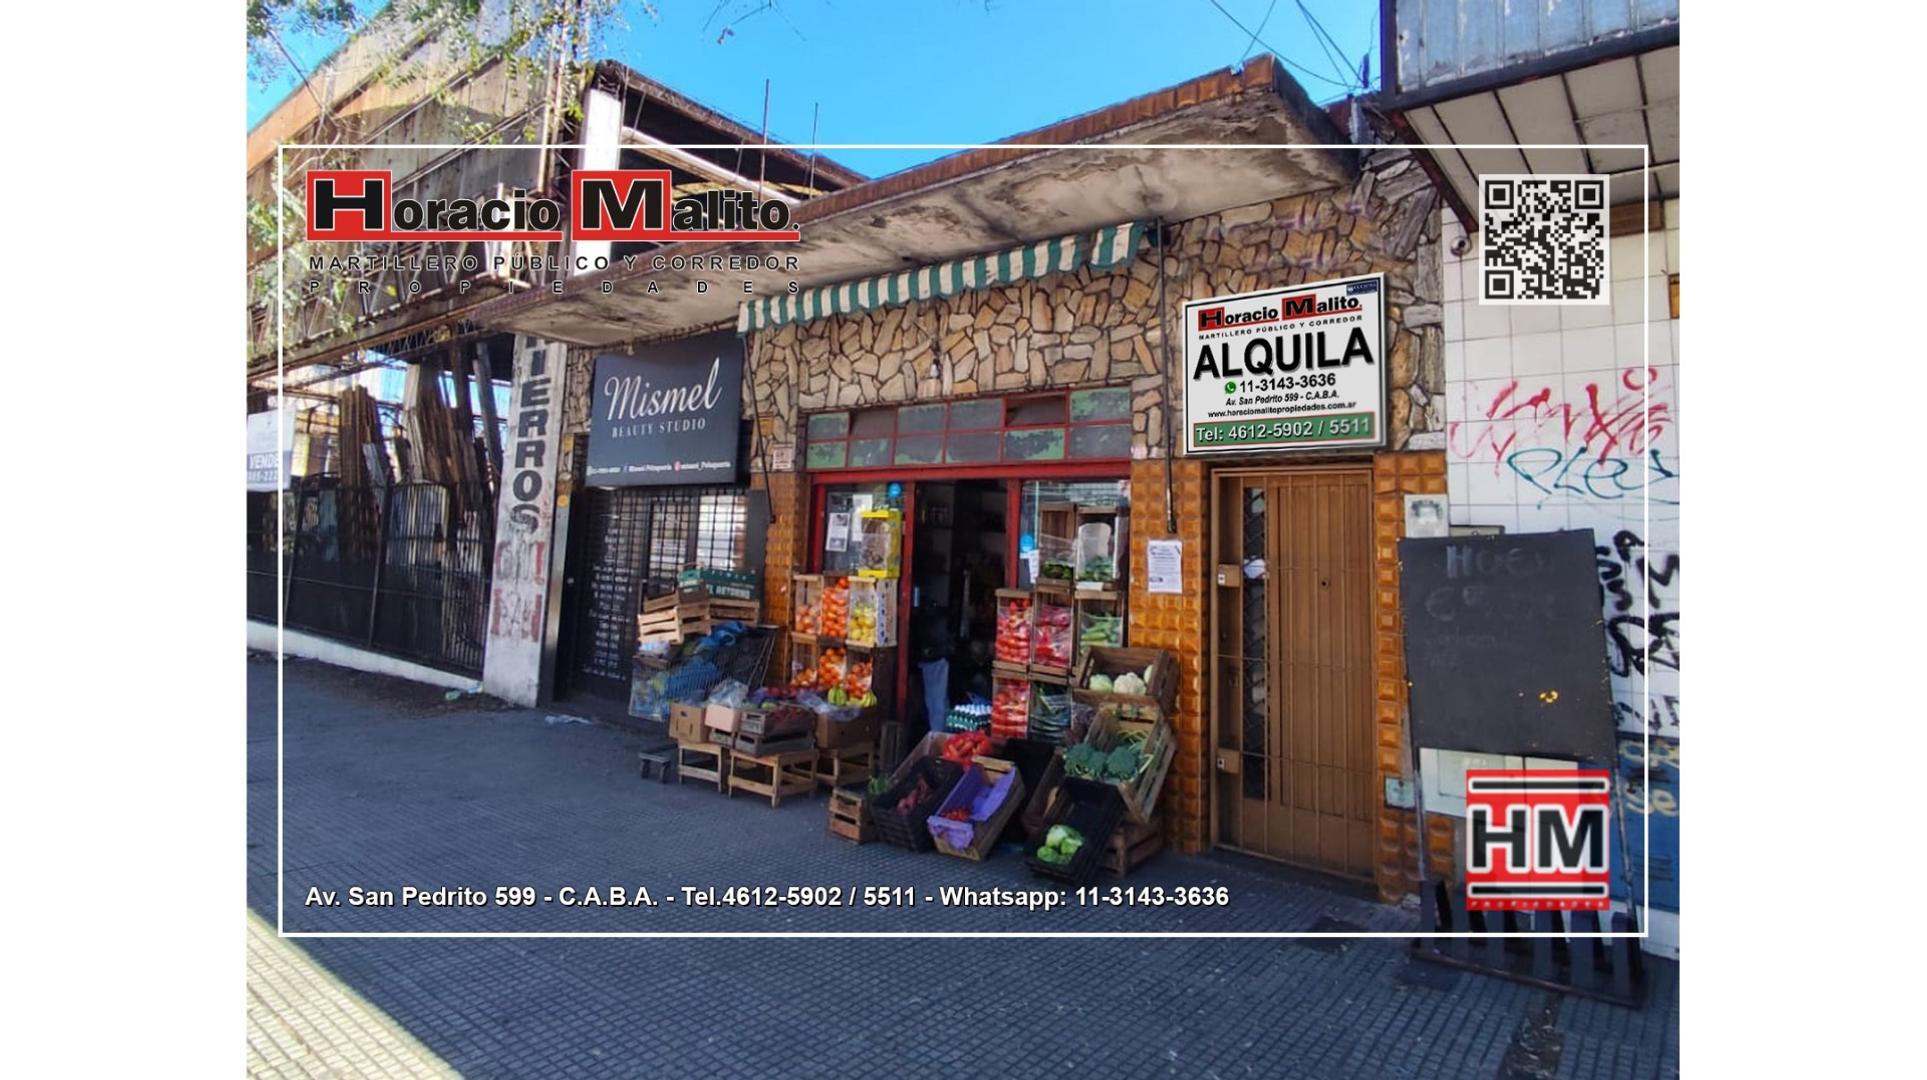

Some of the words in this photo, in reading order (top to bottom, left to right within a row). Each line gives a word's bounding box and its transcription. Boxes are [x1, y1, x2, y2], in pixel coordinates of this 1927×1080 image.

[1199, 327, 1252, 340] MARTILLERO
[1256, 323, 1295, 334] PÚBLICO
[1309, 315, 1363, 328] CORREDOR
[1200, 306, 1279, 328] Horacio
[1193, 326, 1375, 380] ALQUILA
[604, 357, 722, 421] Mismel
[1240, 373, 1337, 394] 11-3143-3636
[1225, 398, 1237, 406] Av.
[1239, 397, 1253, 405] San
[1255, 394, 1283, 405] Pedrito
[1284, 393, 1299, 402] 599
[1306, 390, 1340, 401] C.A.B.A.
[611, 423, 653, 439] BEAUTY
[659, 418, 706, 434] STUDIO
[1196, 428, 1224, 441] Tel:
[1228, 421, 1313, 439] 4612-5902
[1329, 417, 1370, 434] 5511
